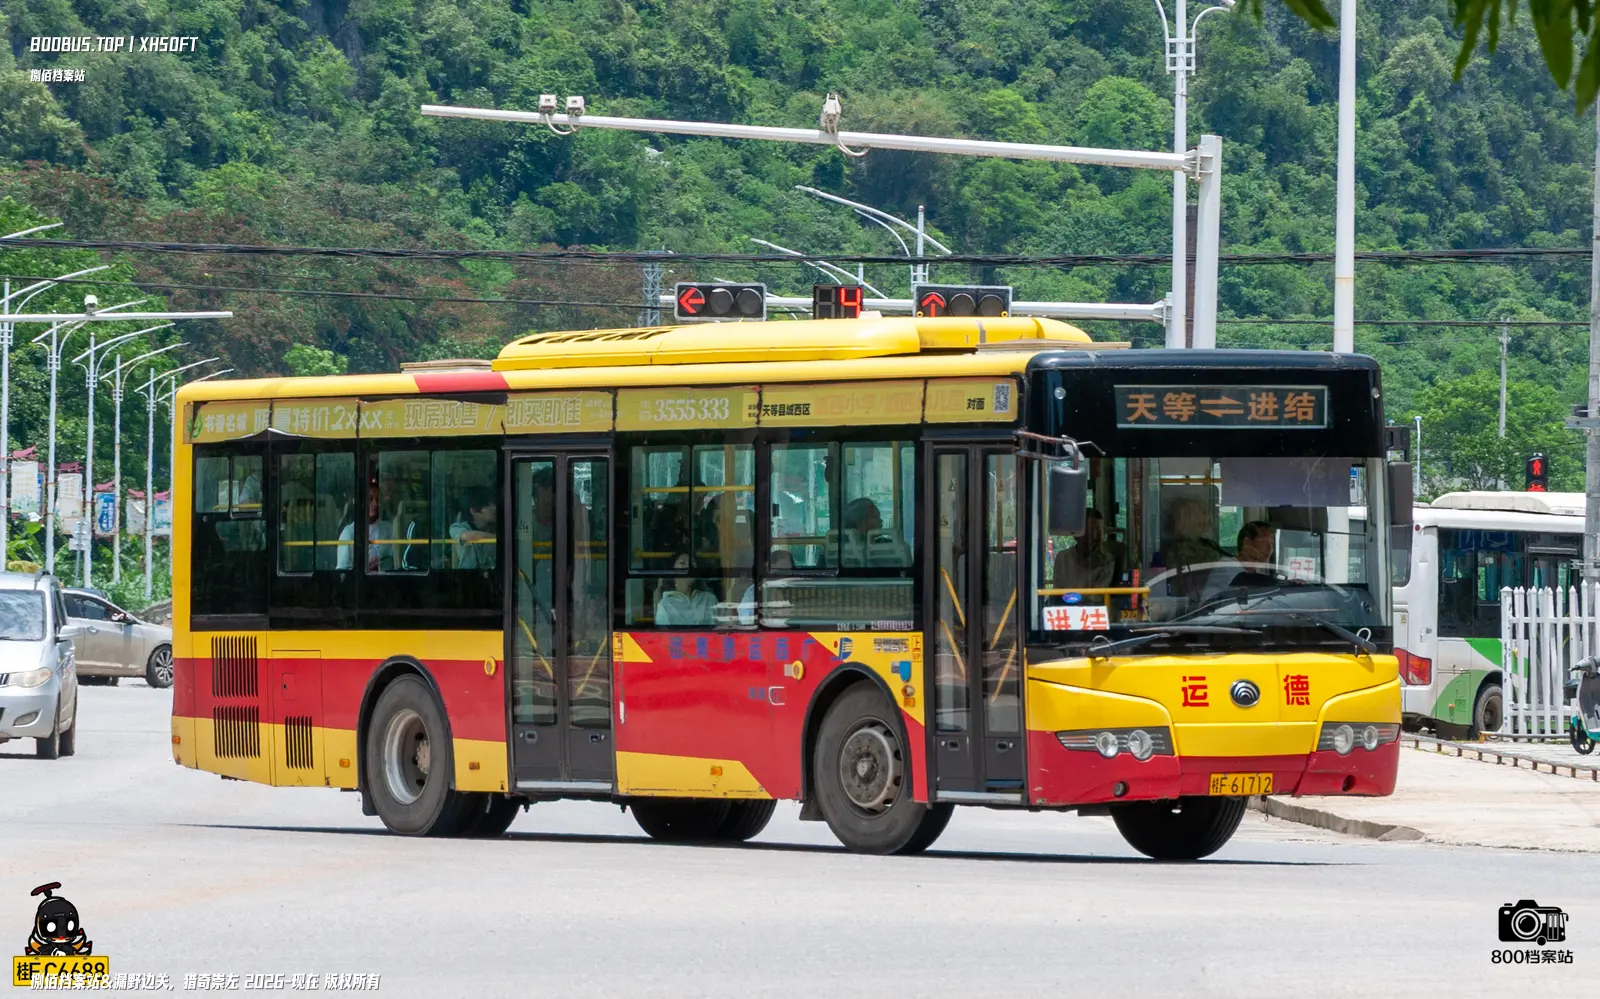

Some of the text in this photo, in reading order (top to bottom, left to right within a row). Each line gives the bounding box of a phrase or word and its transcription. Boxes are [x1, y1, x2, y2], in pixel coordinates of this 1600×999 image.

[840, 287, 861, 319] 4
[966, 397, 985, 410] 对面
[1126, 392, 1316, 422] 天等 进结
[1181, 674, 1310, 707] 运 德
